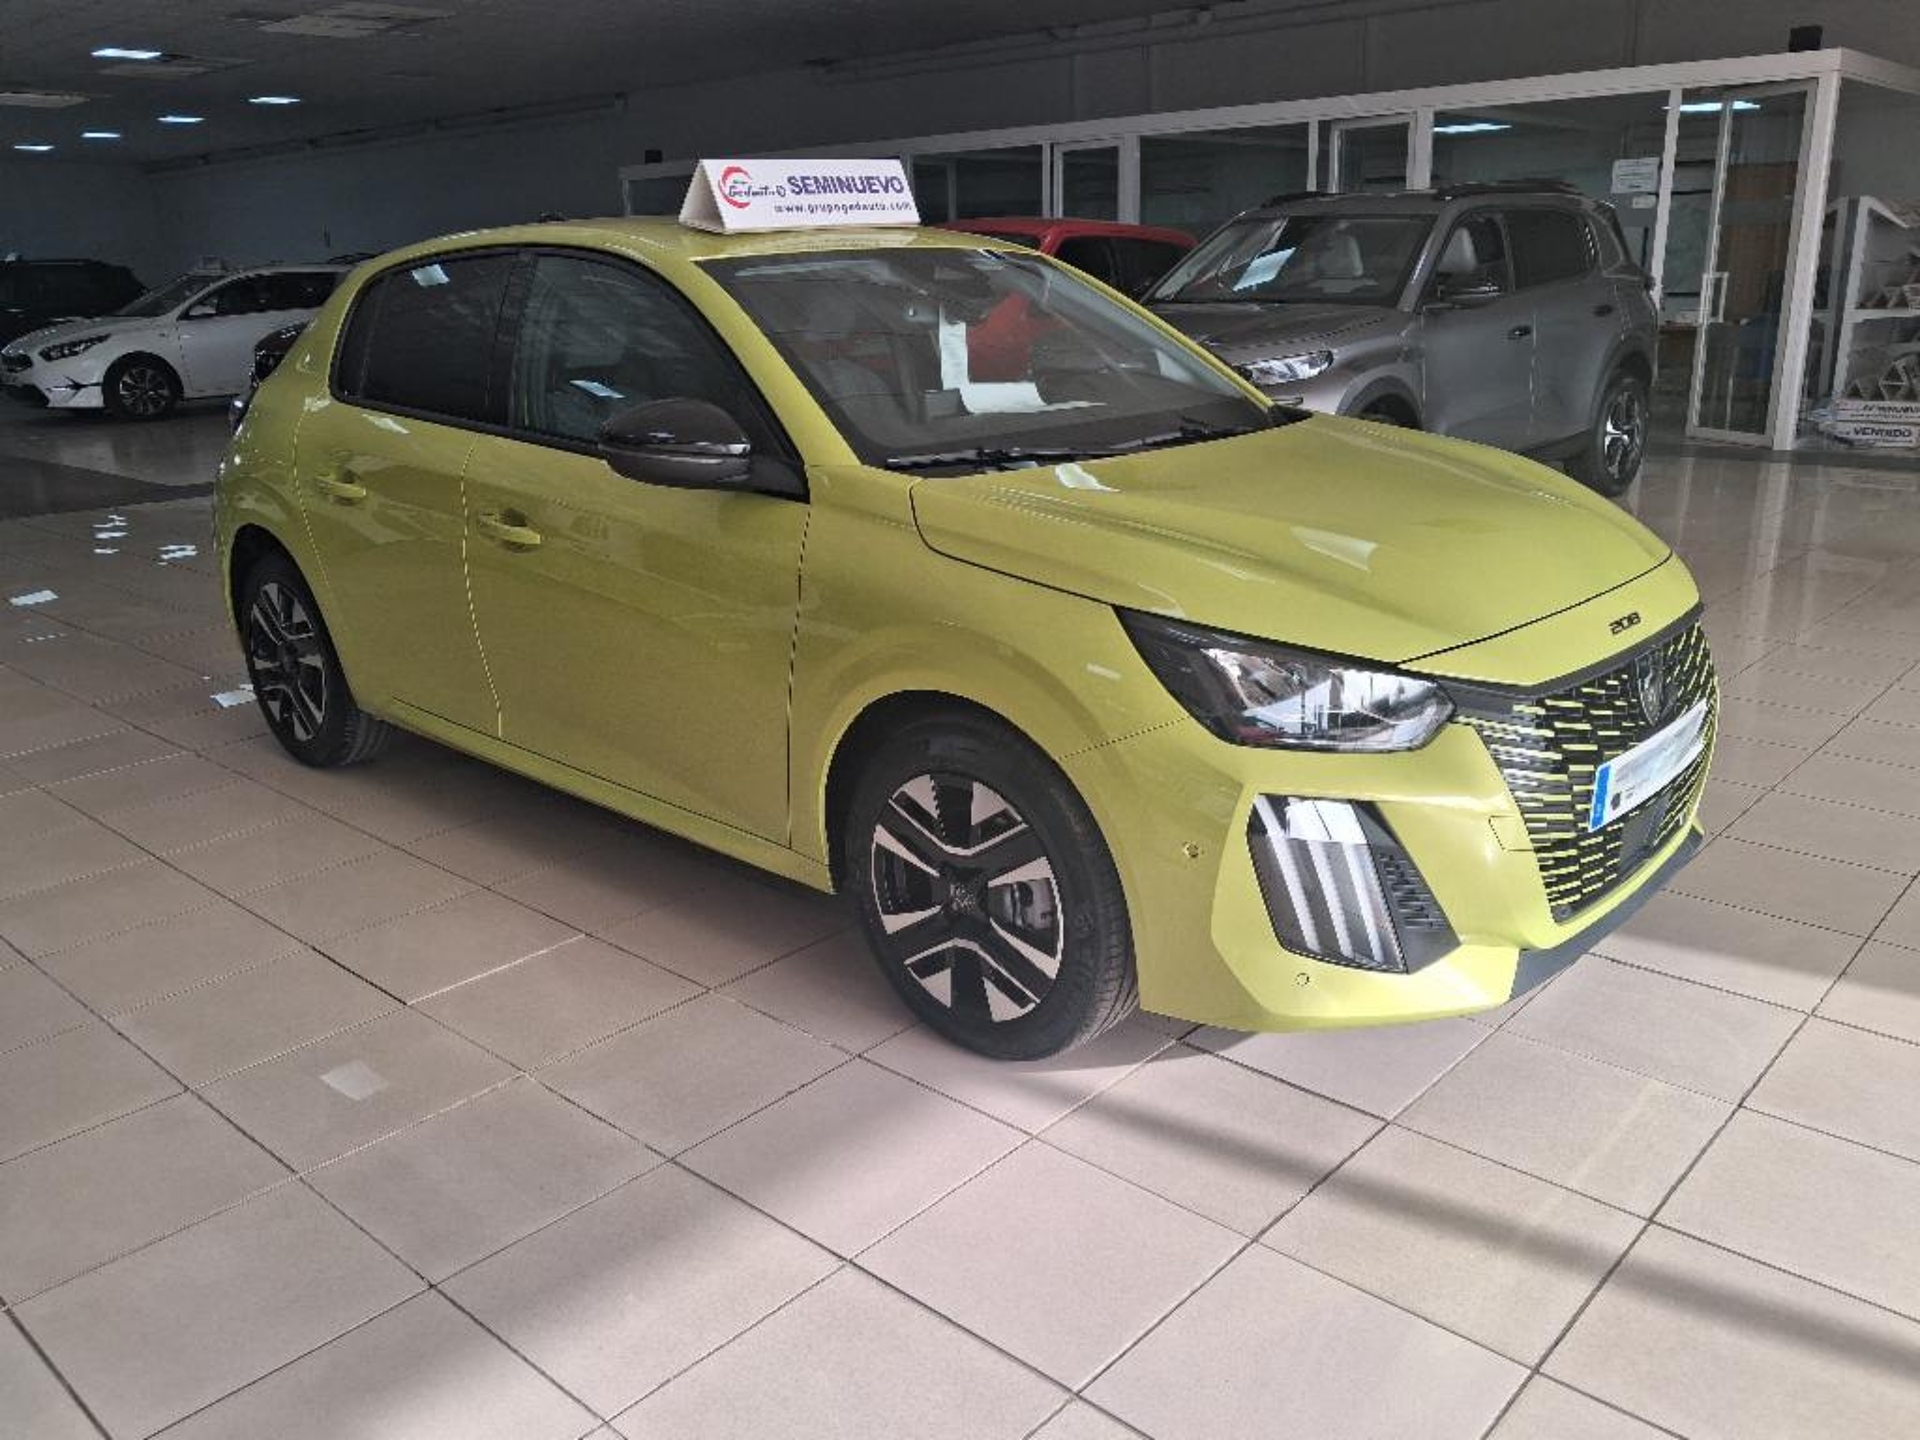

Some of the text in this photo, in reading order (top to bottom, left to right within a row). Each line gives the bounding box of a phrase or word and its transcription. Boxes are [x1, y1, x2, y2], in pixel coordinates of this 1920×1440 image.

[787, 175, 905, 195] SEMINUEVO
[773, 202, 912, 214] www.grupogedauto.com
[1608, 611, 1642, 635] 208
